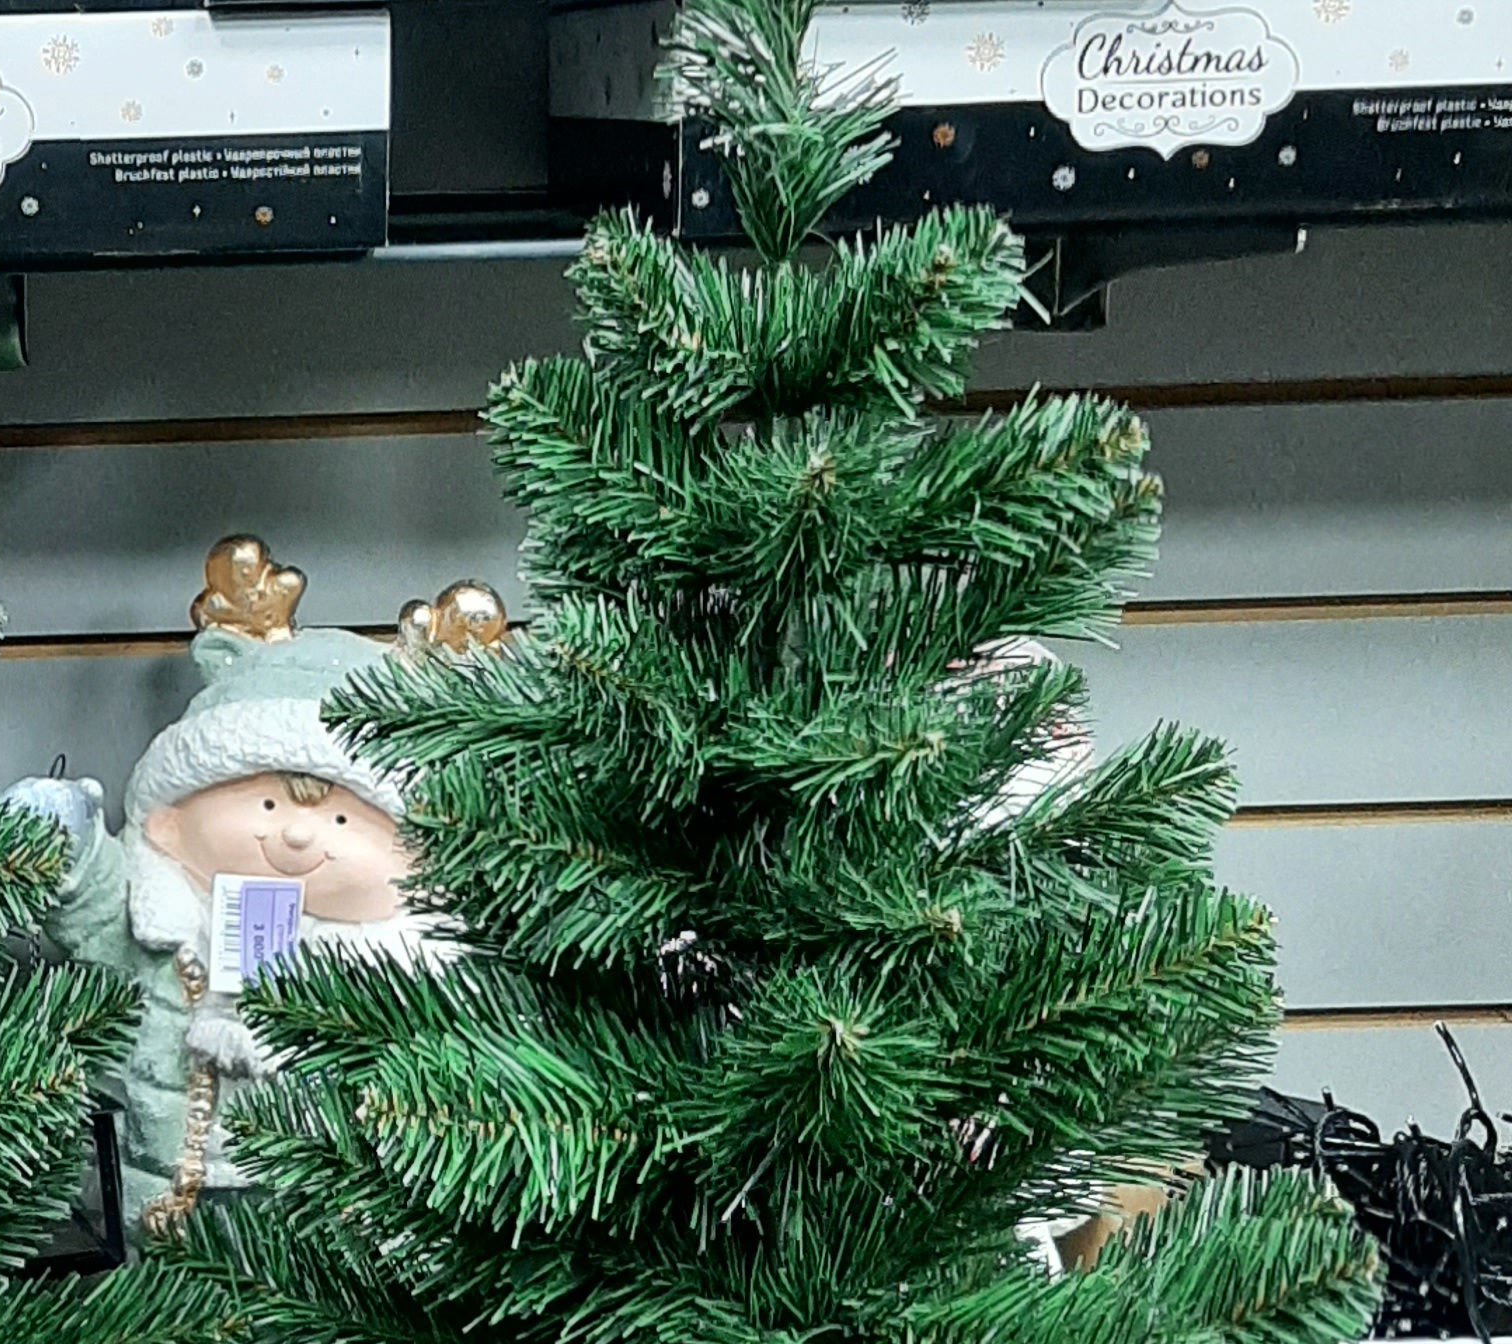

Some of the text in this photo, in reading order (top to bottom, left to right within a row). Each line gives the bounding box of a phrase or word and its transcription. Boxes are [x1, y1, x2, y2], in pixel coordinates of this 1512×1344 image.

[1078, 32, 1270, 81] Christmas
[1078, 83, 1262, 114] Decorations
[89, 150, 169, 167] Shatterproof
[171, 149, 213, 165] plastic
[178, 167, 220, 183] plastic
